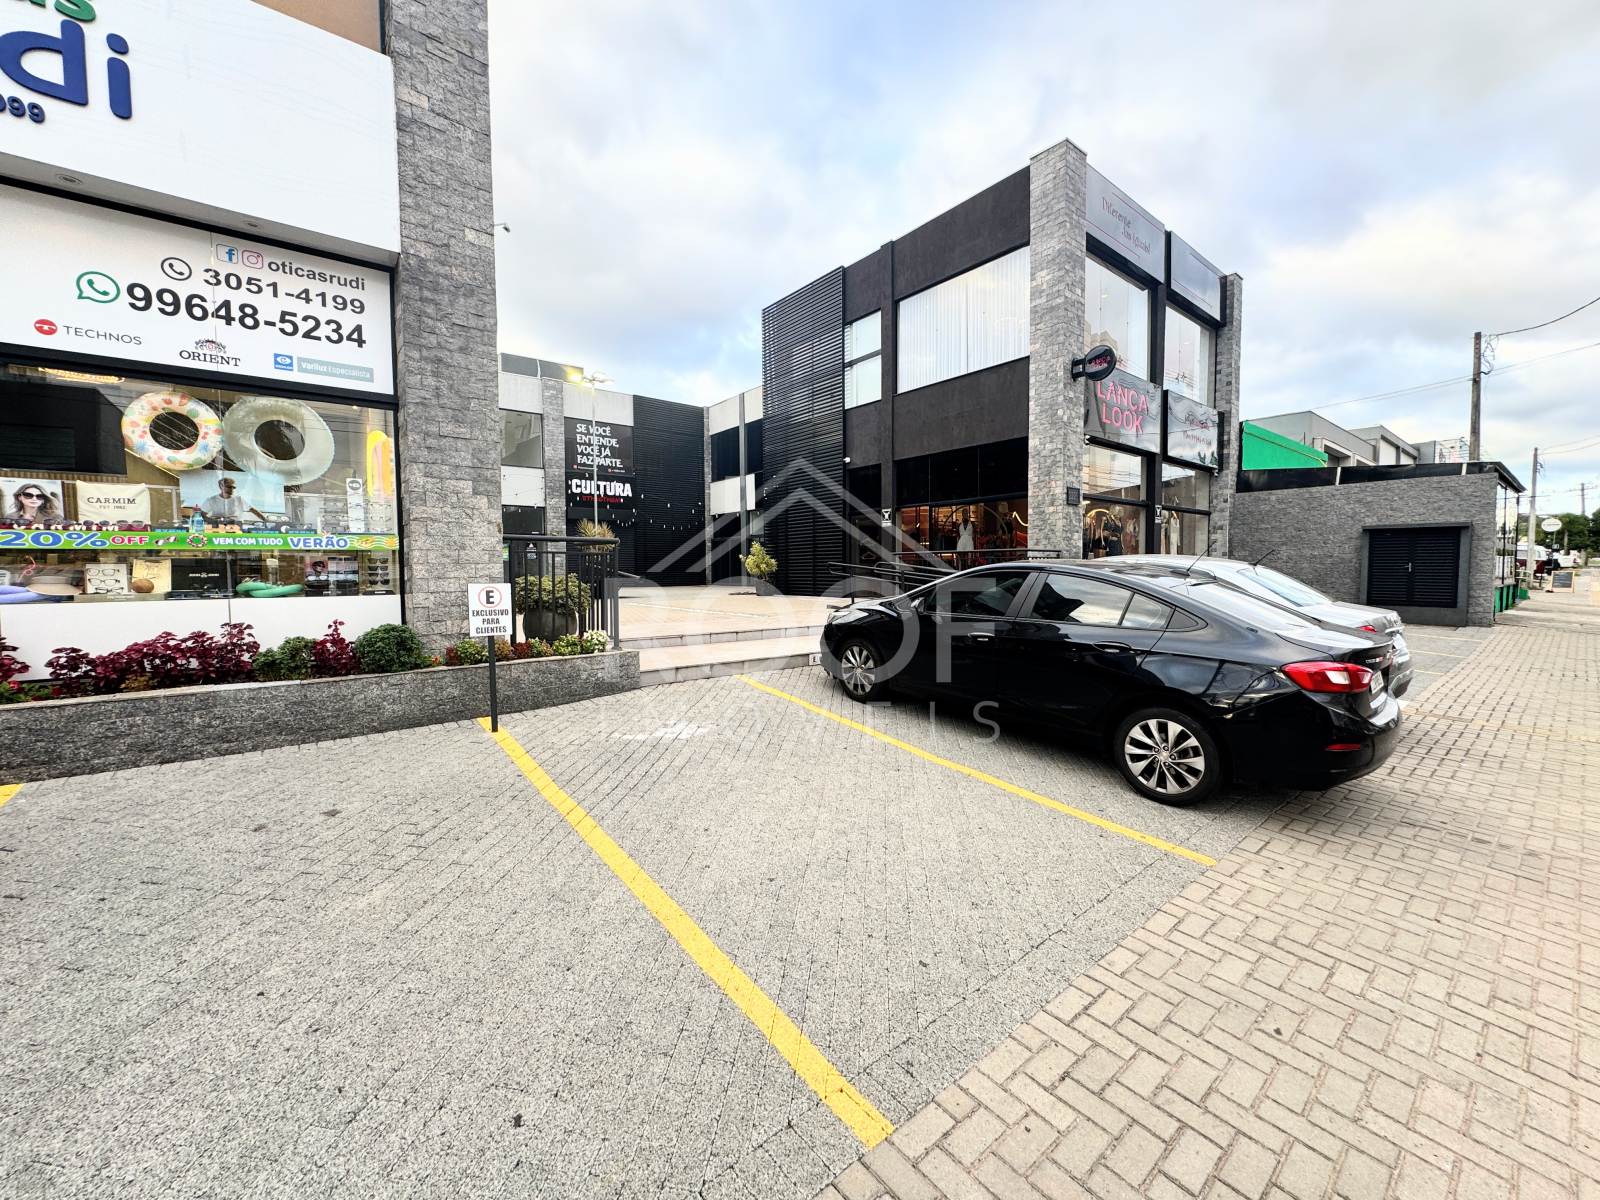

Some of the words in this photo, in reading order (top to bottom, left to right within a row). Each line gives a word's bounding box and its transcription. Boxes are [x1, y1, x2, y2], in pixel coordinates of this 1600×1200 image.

[267, 258, 366, 292] oticasrudi
[202, 267, 366, 315] 3051-4199
[126, 282, 367, 349] 99648-5234
[63, 325, 143, 346] TECHNOS
[179, 349, 241, 368] ORIENT
[1102, 403, 1144, 434] LOOK
[576, 424, 587, 433] SE
[577, 455, 594, 465] FAZ
[572, 479, 632, 497] CULTURA
[0, 532, 110, 549] 20%
[111, 535, 150, 546] OFF
[213, 537, 235, 546] VEM
[235, 537, 256, 546] COM
[257, 537, 284, 547] TUDO
[289, 535, 349, 549] VERÃO
[486, 590, 495, 604] E
[472, 609, 509, 617] EXCLUSIVO
[476, 626, 507, 634] CLIENTES
